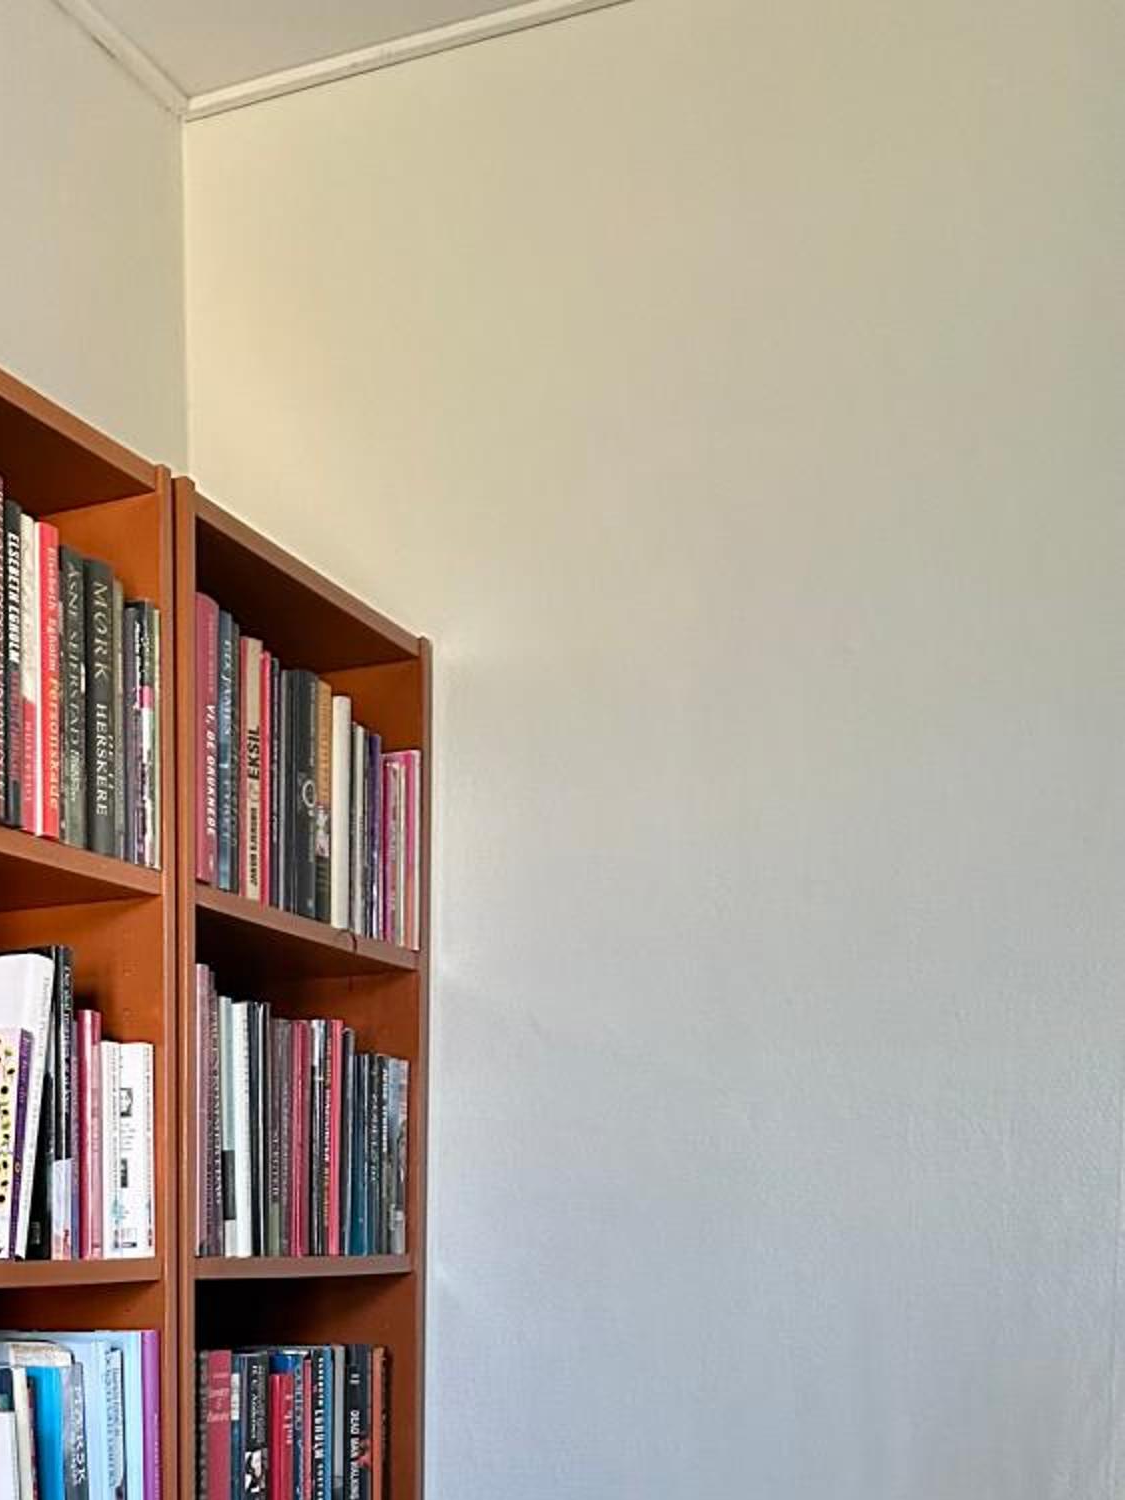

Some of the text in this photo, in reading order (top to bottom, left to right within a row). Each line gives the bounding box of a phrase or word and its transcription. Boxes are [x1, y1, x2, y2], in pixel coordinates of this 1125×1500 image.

[8, 532, 21, 602] ELSEBETH
[8, 605, 21, 664] EGHOLM
[93, 581, 109, 681] MØRK
[95, 703, 109, 817] HERSKERE
[248, 726, 261, 780] EKSIL
